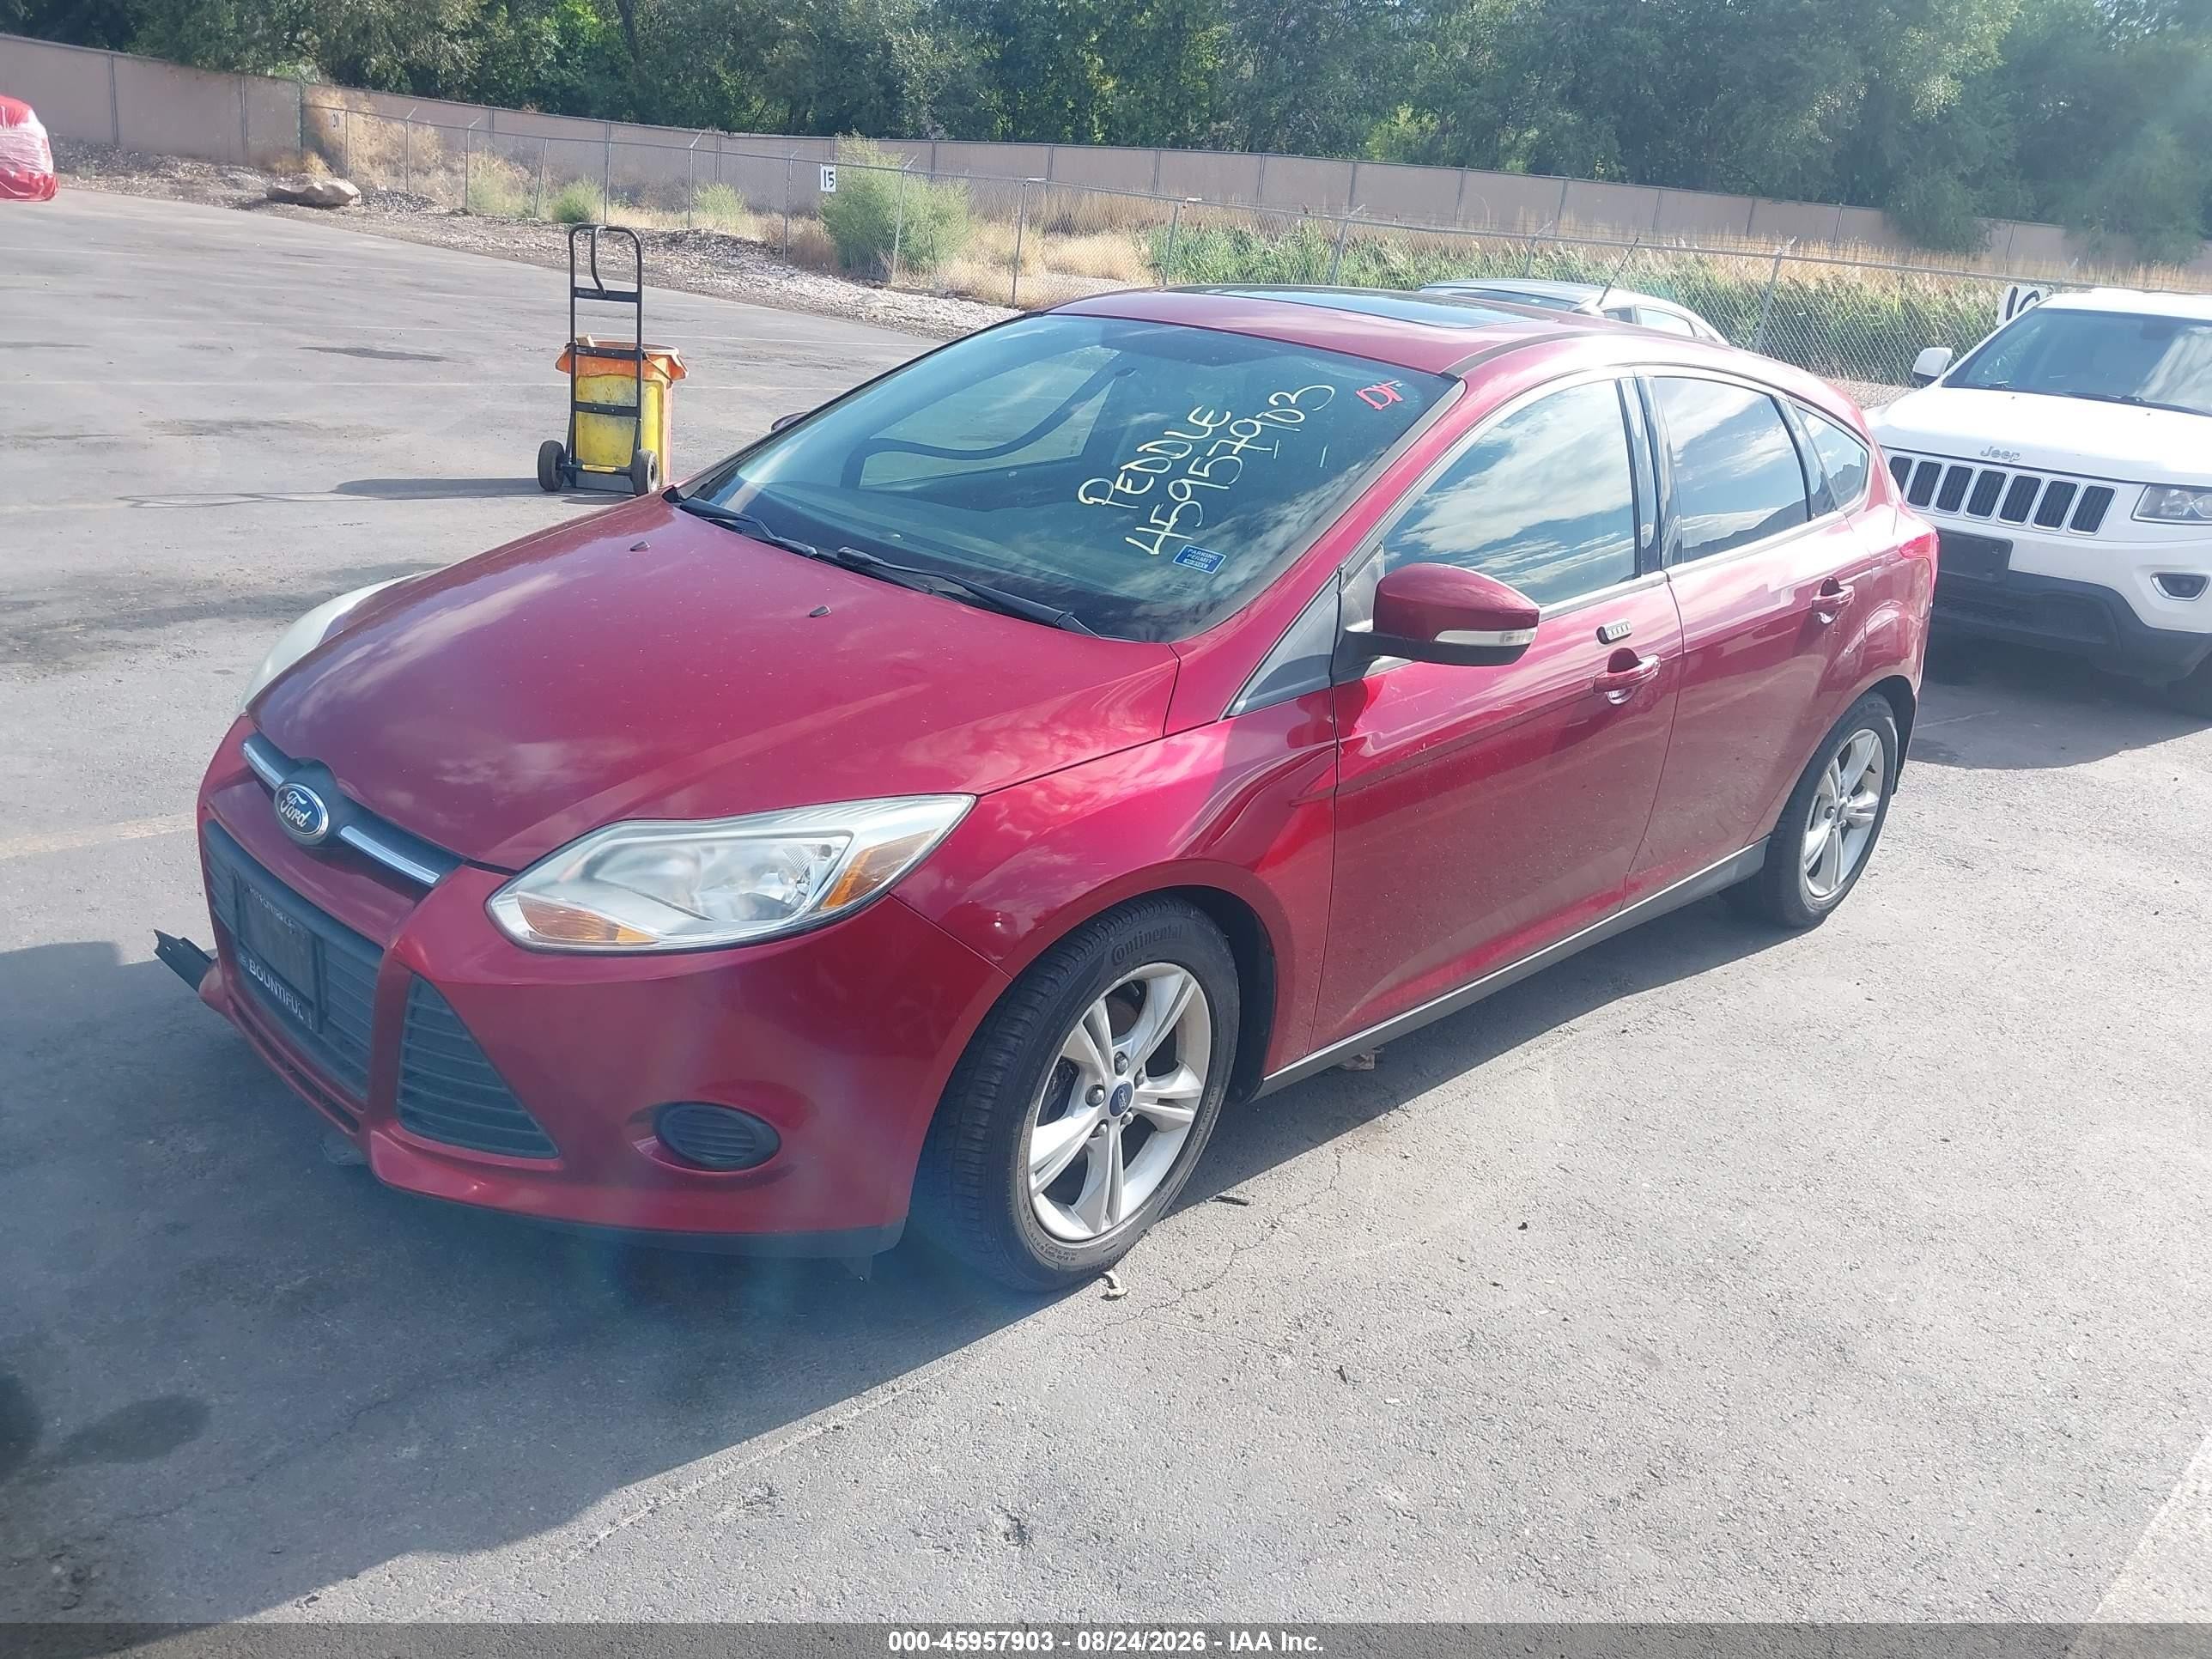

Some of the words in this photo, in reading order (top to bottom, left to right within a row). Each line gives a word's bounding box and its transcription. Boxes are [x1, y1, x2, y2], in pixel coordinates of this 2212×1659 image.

[823, 168, 835, 188] 15
[1078, 404, 1231, 508] PEDDLE
[1125, 384, 1335, 556] 45957903
[1979, 446, 2021, 463] Jeep
[1186, 554, 1213, 564] PERMIT
[1188, 549, 1218, 560] PARKING
[280, 790, 312, 828] Ford
[1112, 923, 1182, 963] Continental
[248, 958, 304, 1020] BOUNTIFUL
